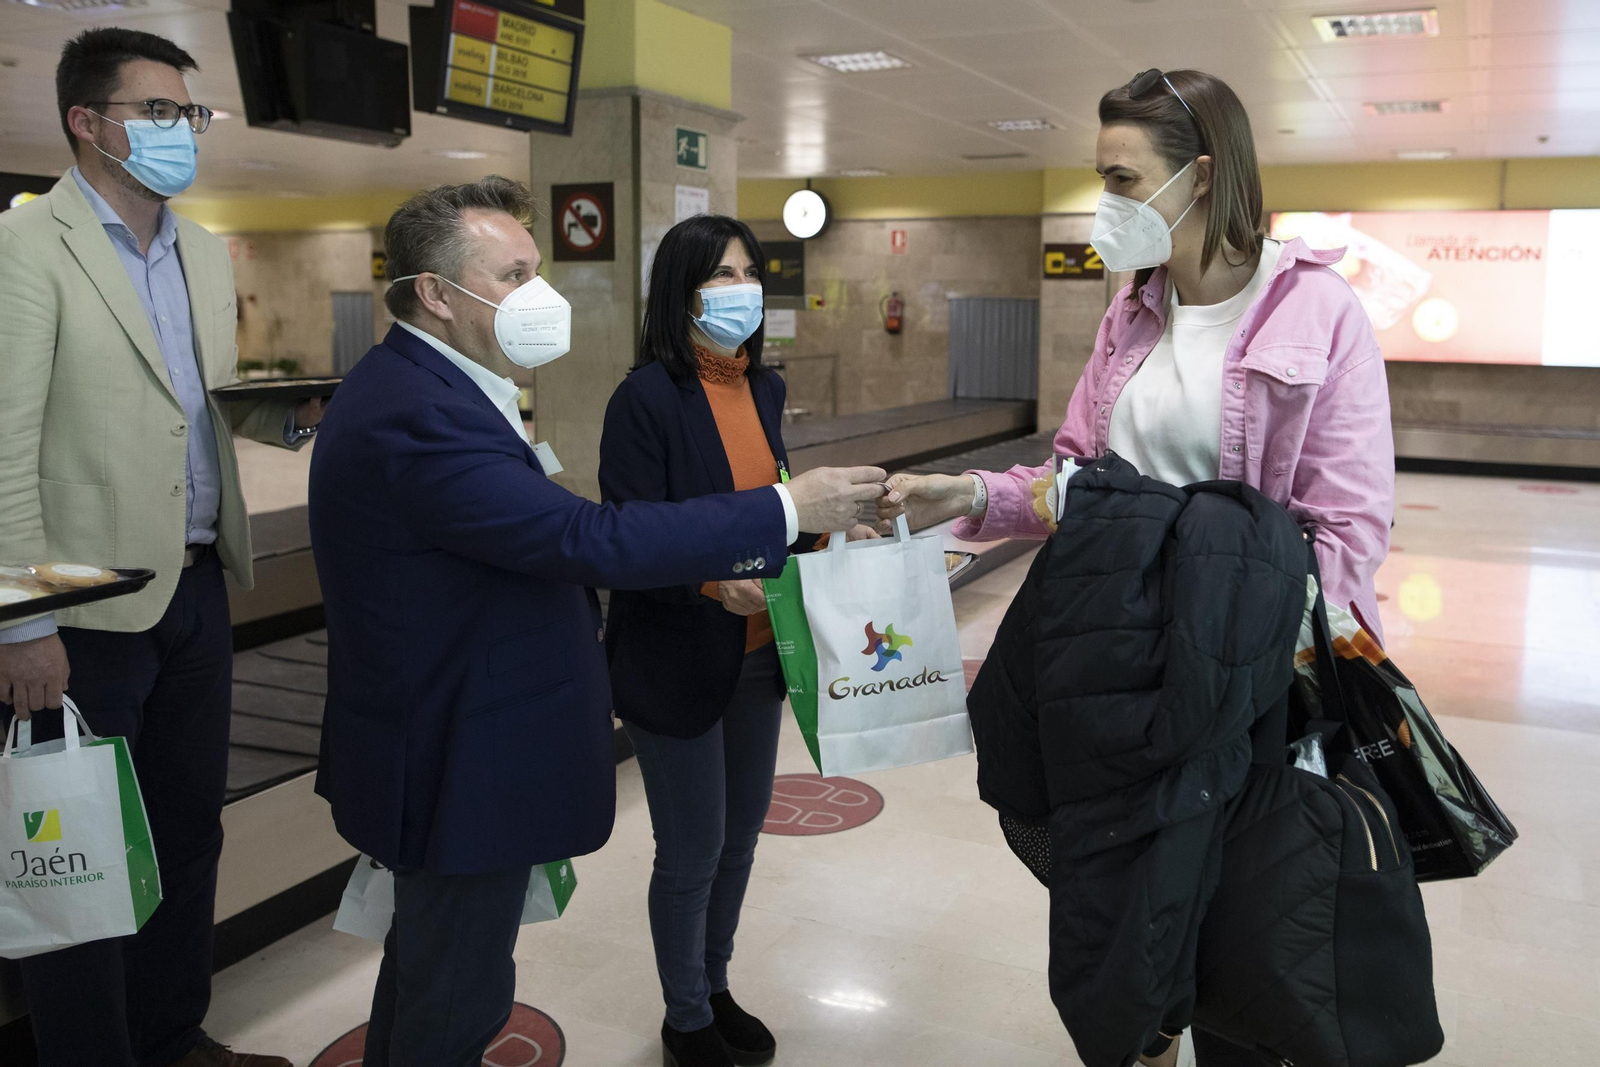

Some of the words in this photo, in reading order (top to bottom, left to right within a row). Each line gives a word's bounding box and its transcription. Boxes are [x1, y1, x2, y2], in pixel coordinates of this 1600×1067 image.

[501, 18, 537, 36] MADRID
[457, 48, 486, 64] vueling
[497, 51, 529, 67] BILBAO
[454, 80, 482, 96] vueling
[493, 83, 544, 102] BARCELONA
[1427, 242, 1542, 262] ATENCIÓN
[828, 666, 949, 700] Granada
[10, 847, 87, 878] Jaén
[5, 877, 48, 889] PARAÍSO
[50, 872, 105, 887] INTERIOR
